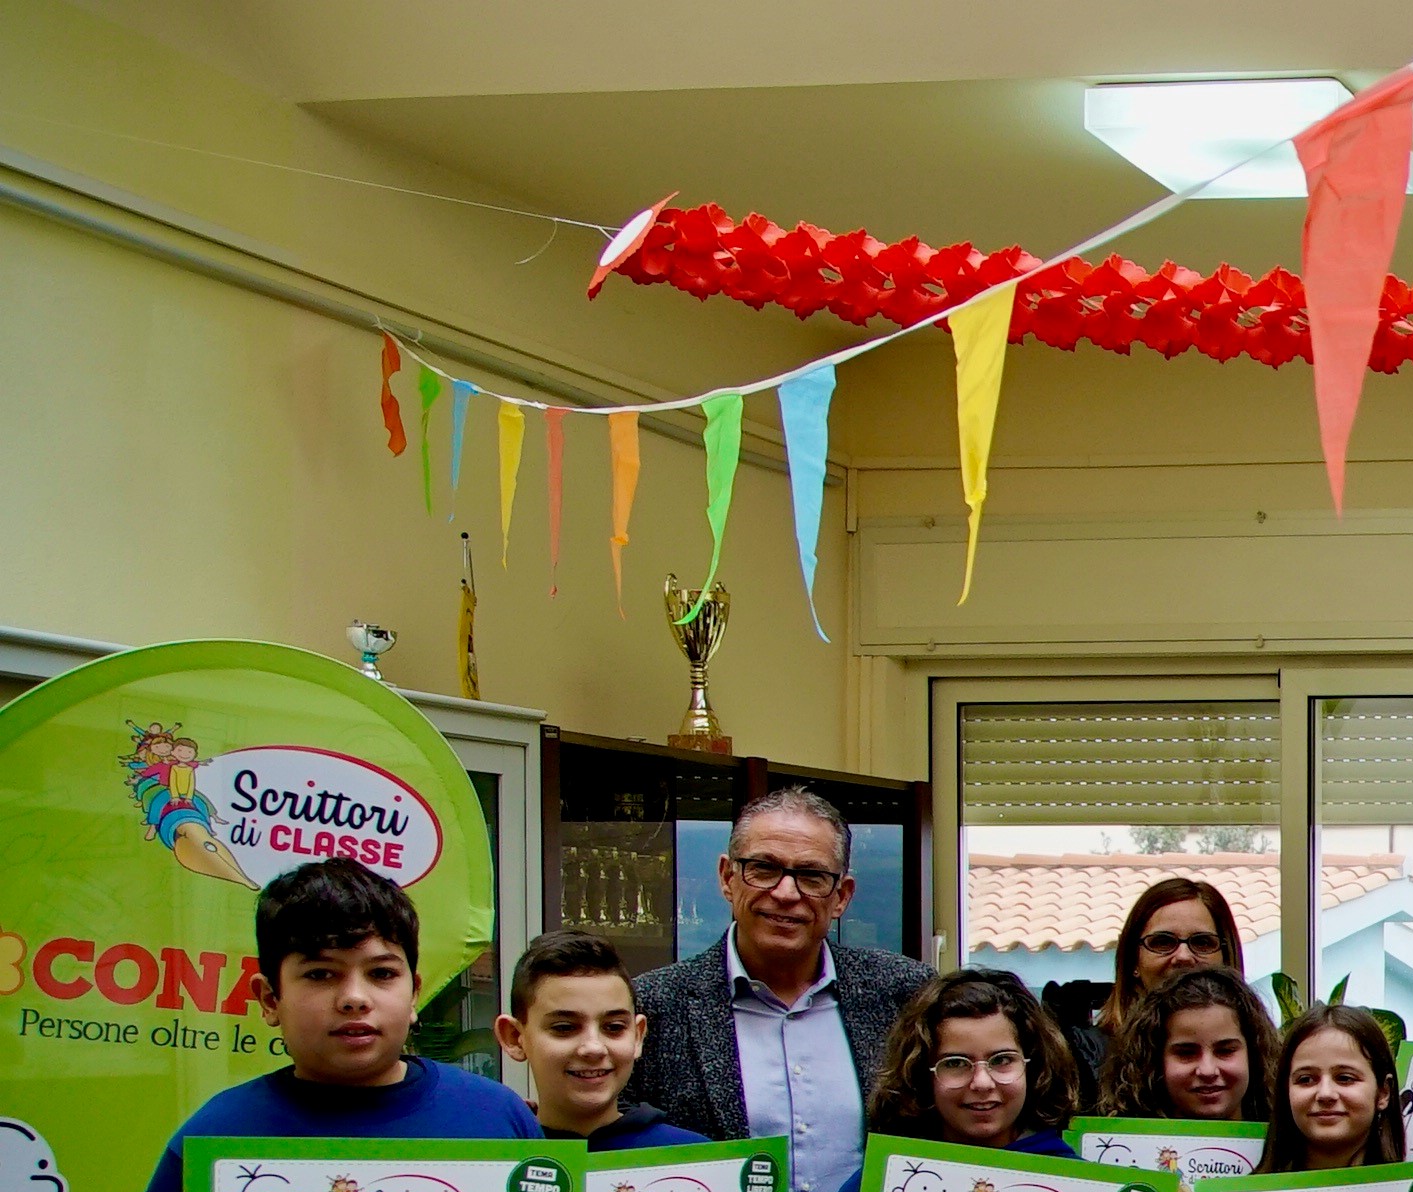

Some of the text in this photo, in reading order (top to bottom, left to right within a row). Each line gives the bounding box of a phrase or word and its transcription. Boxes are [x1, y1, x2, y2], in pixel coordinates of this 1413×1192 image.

[231, 769, 409, 837] Scrittori
[230, 818, 404, 869] di CLASSE
[19, 1008, 139, 1044] Persone
[151, 1024, 220, 1050] oltre
[231, 1031, 257, 1054] le
[1188, 1158, 1243, 1174] Scrittori
